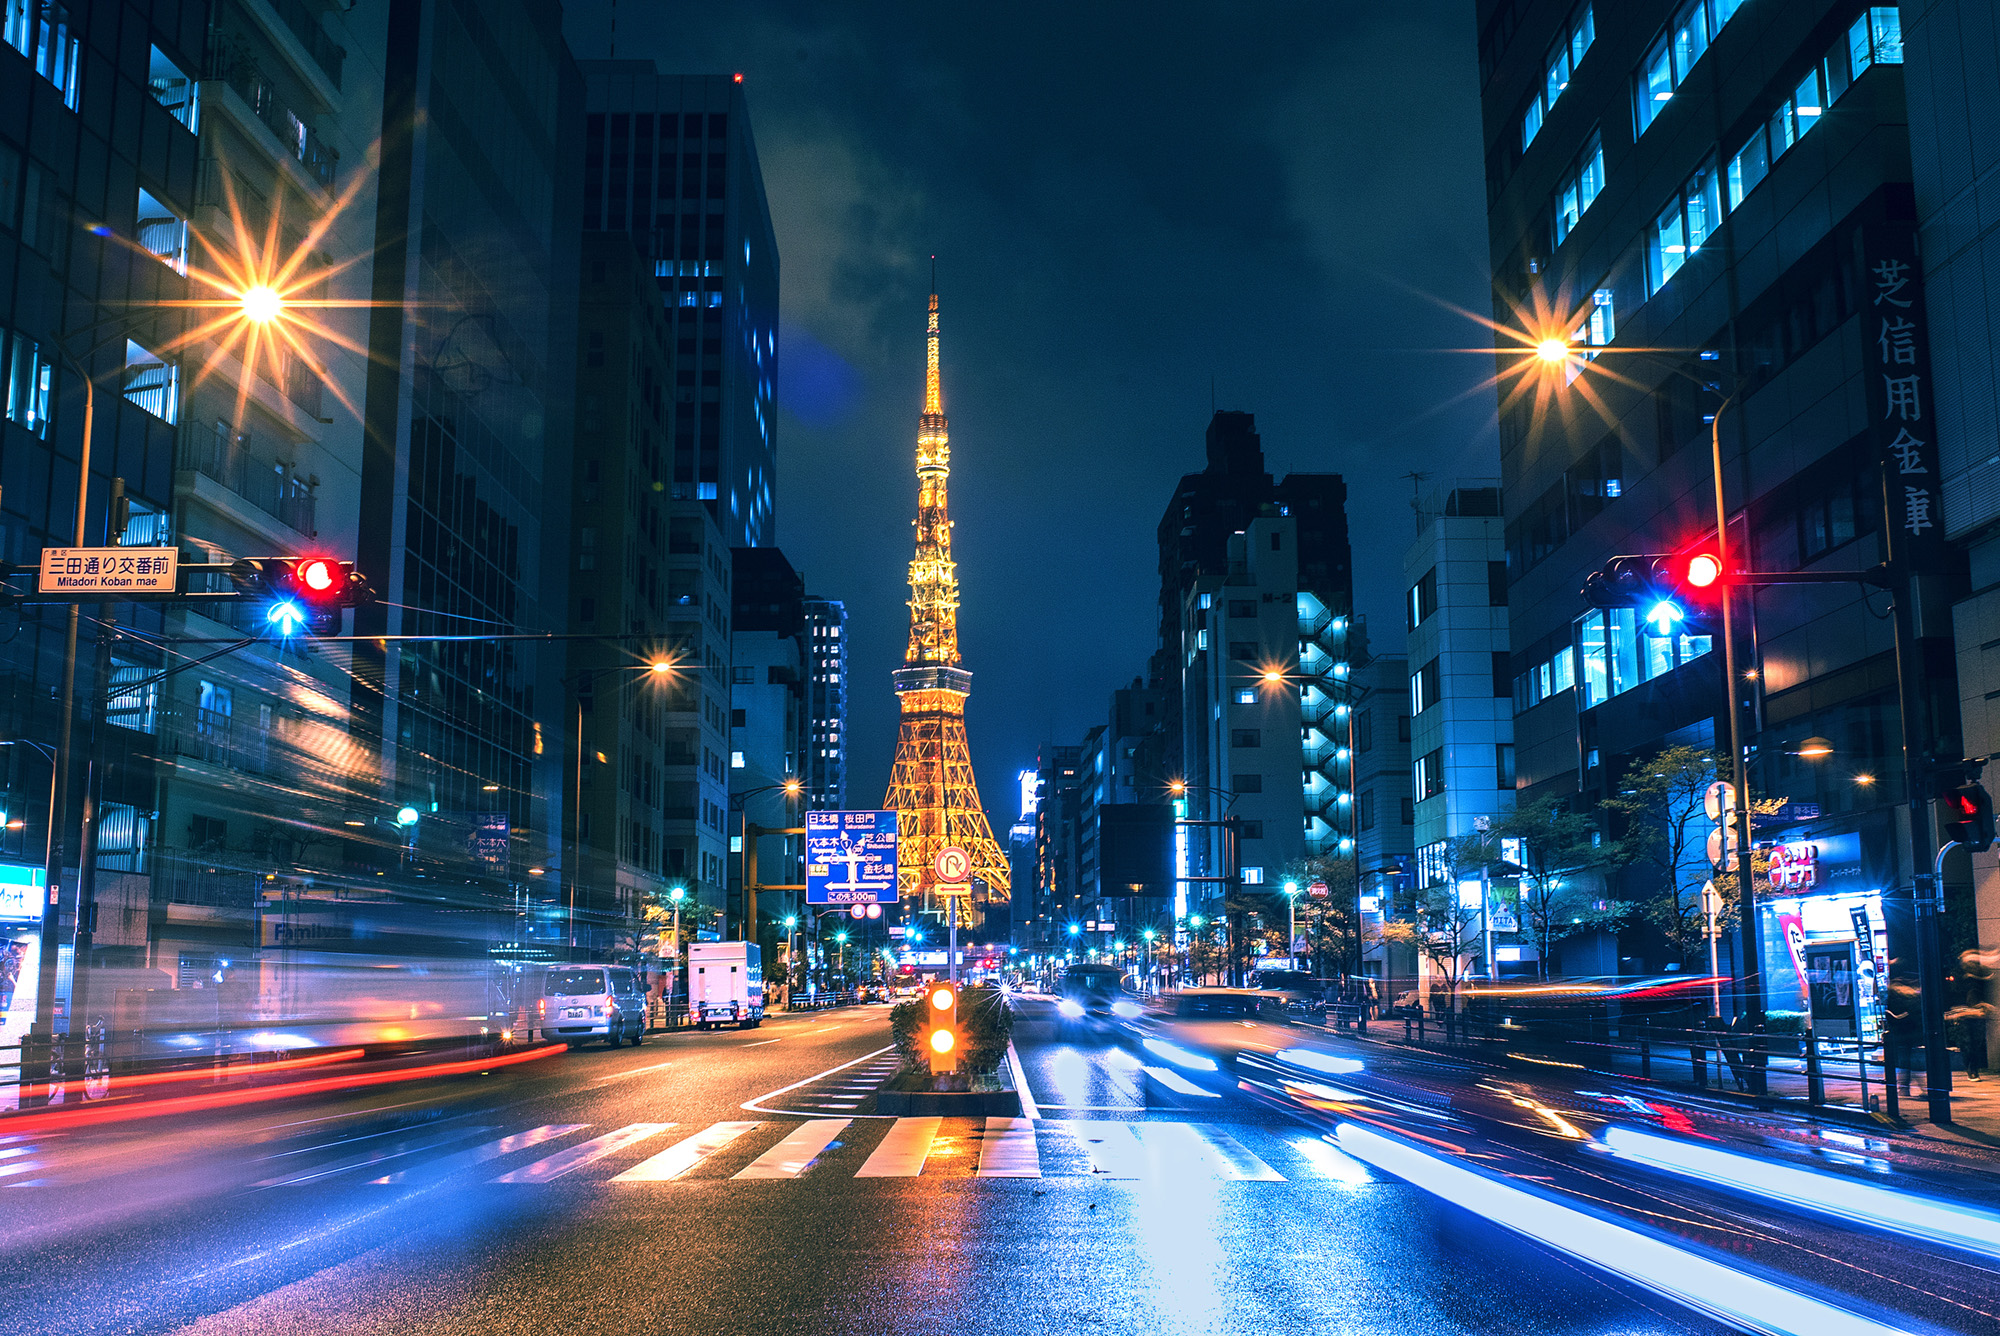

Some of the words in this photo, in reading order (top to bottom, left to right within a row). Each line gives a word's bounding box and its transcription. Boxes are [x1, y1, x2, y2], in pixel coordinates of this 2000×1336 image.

[1871, 258, 1934, 537] 芝信用金庫
[48, 556, 169, 575] 三田通り交番前
[57, 576, 98, 586] Mitadori
[101, 576, 132, 586] Koban
[136, 578, 158, 586] mae
[1263, 593, 1293, 603] M-2
[808, 814, 839, 824] 日本橋
[844, 813, 876, 824] 桜田門
[808, 837, 840, 848] 六本木
[865, 833, 896, 843] 芝公園
[864, 864, 894, 874] 金杉橋
[1493, 916, 1513, 924] MITA
